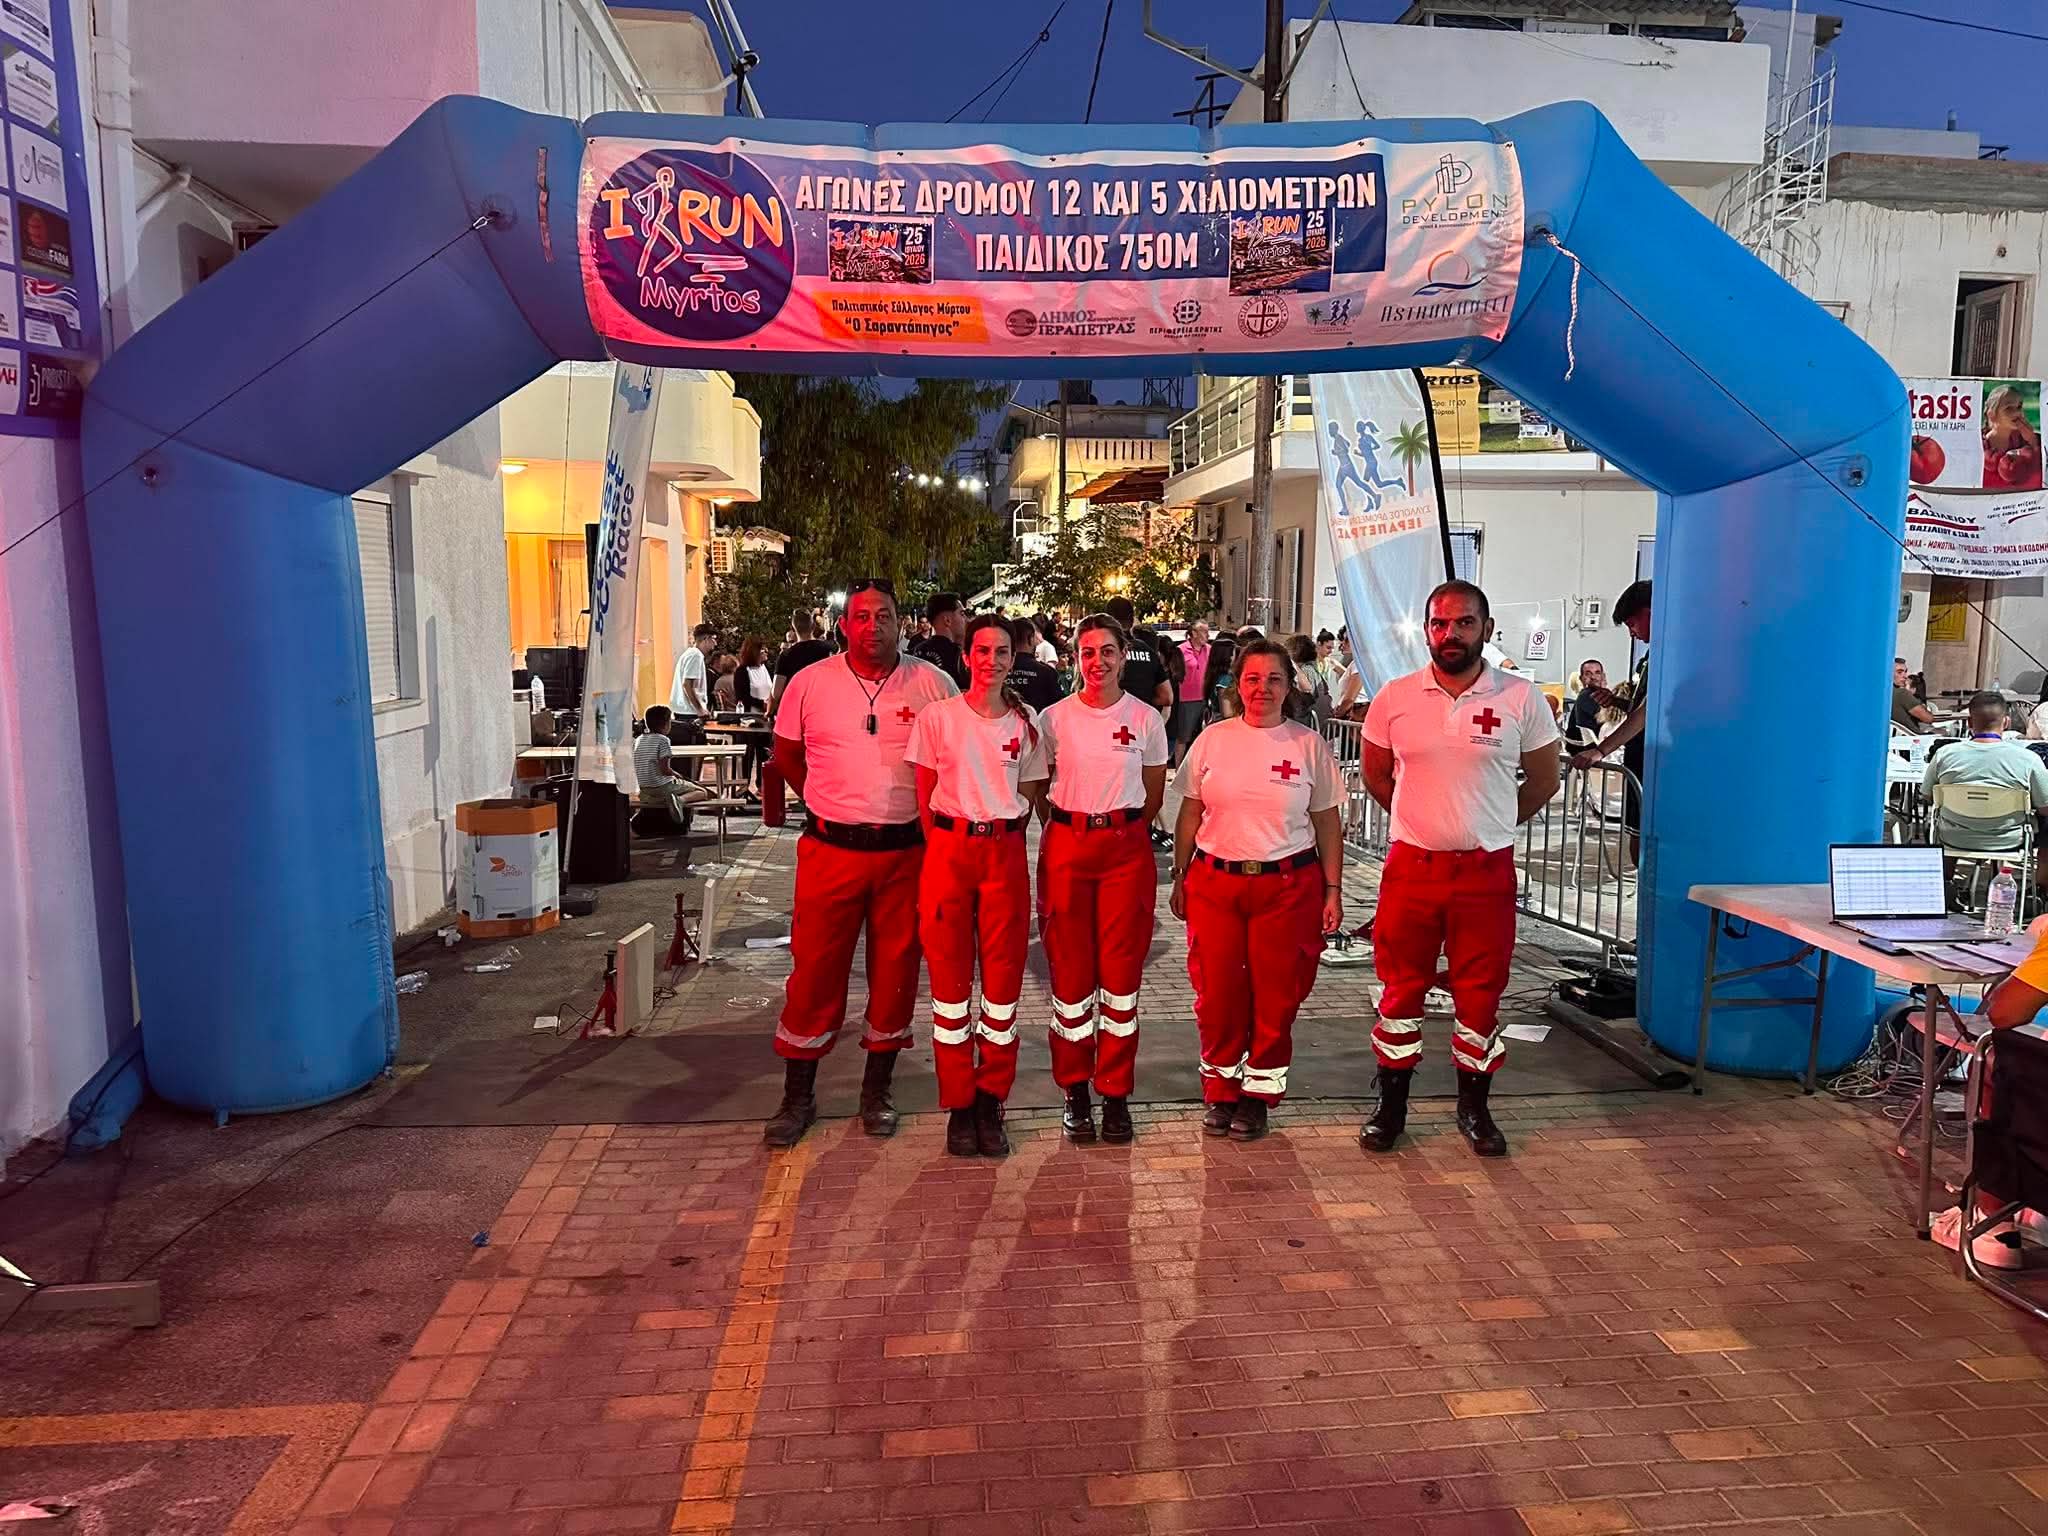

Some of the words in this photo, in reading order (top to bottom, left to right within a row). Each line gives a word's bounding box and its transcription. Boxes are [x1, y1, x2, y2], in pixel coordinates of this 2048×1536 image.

[795, 175, 906, 214] ΑΓΩΝΕΣ
[915, 179, 1036, 216] ΔΡΟΜΟΥ
[1048, 179, 1082, 216] 12
[1092, 180, 1141, 216] ΚΑΙ
[1151, 180, 1169, 215] 5
[1177, 171, 1377, 215] ΧΙΛΙΟΜΕΤΡΩΝ
[1402, 194, 1508, 213] PYLON
[600, 187, 634, 240] I
[678, 189, 783, 249] RUN
[1262, 213, 1300, 237] RUN
[1306, 210, 1325, 229] 25
[1402, 209, 1508, 225] DEVELOPMENT
[860, 228, 898, 250] RUN
[903, 226, 924, 246] 25
[975, 233, 1109, 273] ΠΑΙΔΙΚΟΣ
[1120, 231, 1199, 272] 750Μ
[640, 276, 761, 318] Myrtos
[832, 299, 889, 315] Πολιτιστικός
[891, 300, 934, 316] Σύλλογος
[937, 302, 971, 318] Μύρτου
[1039, 310, 1096, 324] ΔΗΜΟΣ
[1039, 322, 1136, 337] ΙΕΡΑΠΕΤΡΑΣ
[601, 466, 625, 614] Coast
[610, 482, 635, 580] Race
[1126, 650, 1150, 662] OLICE
